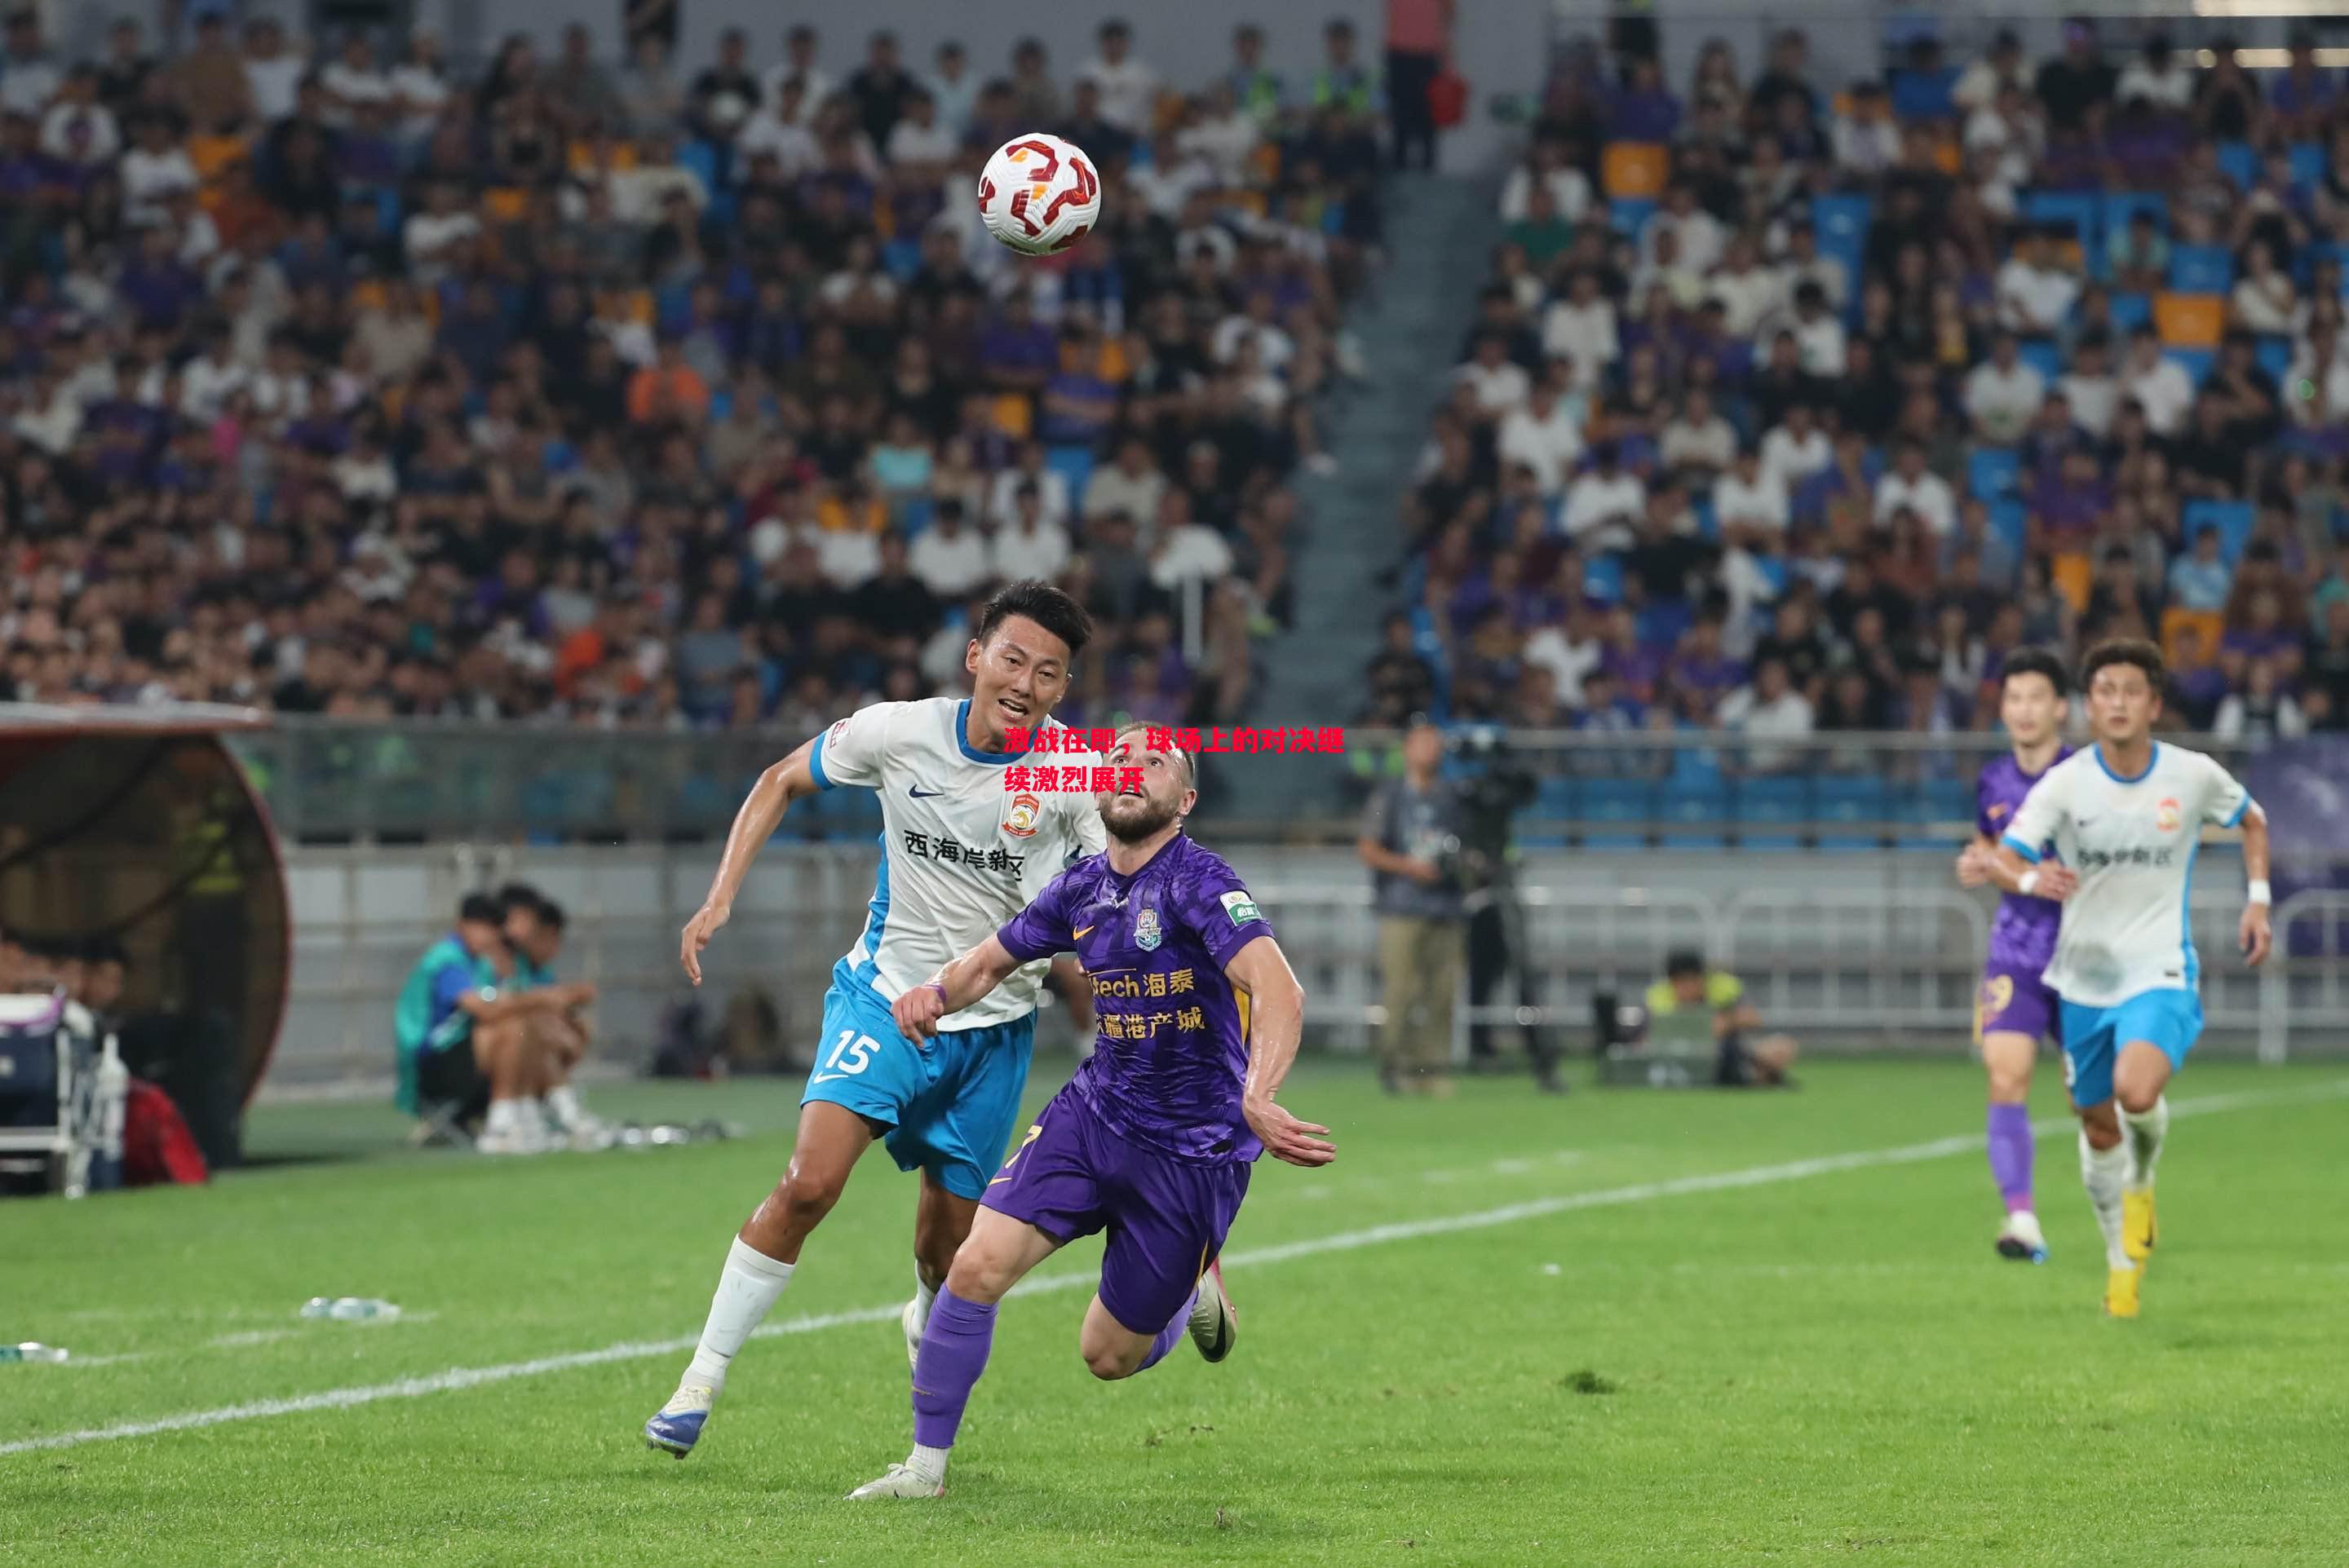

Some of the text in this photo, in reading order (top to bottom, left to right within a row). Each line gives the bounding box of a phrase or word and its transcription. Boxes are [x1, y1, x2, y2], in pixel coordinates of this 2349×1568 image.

[904, 830, 1025, 881] 西海岸新区
[1143, 968, 1195, 996] 海泰
[825, 1030, 881, 1075] 15
